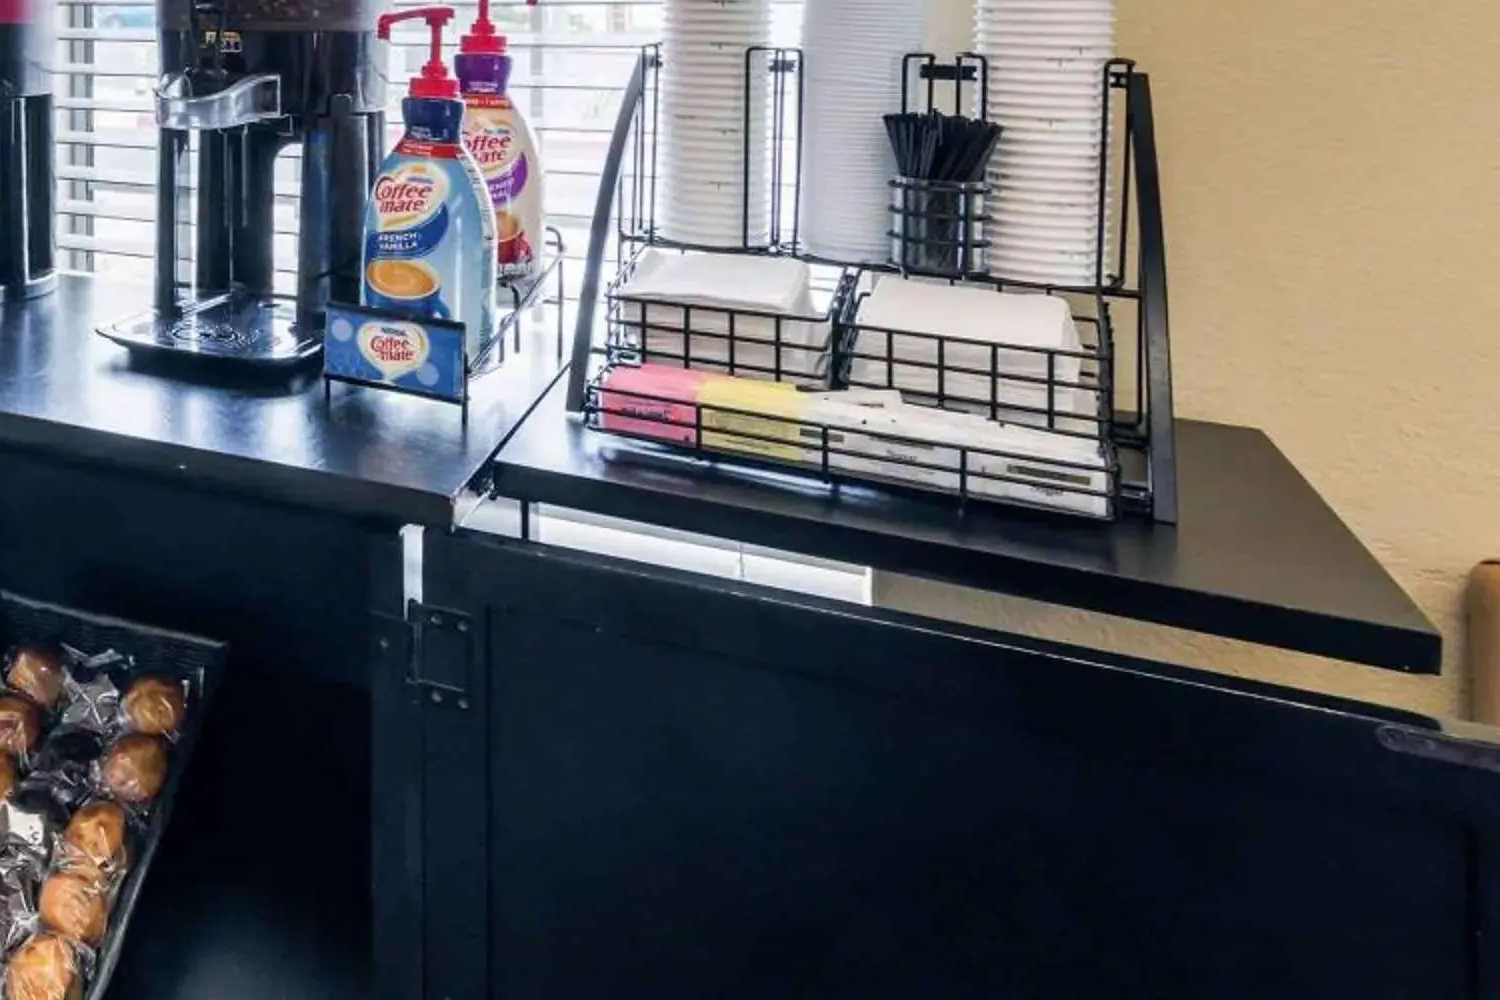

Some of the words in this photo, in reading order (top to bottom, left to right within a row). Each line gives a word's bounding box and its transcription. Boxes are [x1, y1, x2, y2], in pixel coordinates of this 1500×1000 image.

[462, 131, 511, 151] offee
[376, 176, 433, 200] Coffee
[380, 200, 425, 213] mate
[378, 231, 417, 241] FRENCH
[371, 335, 411, 352] Coffee
[380, 350, 413, 361] mate
